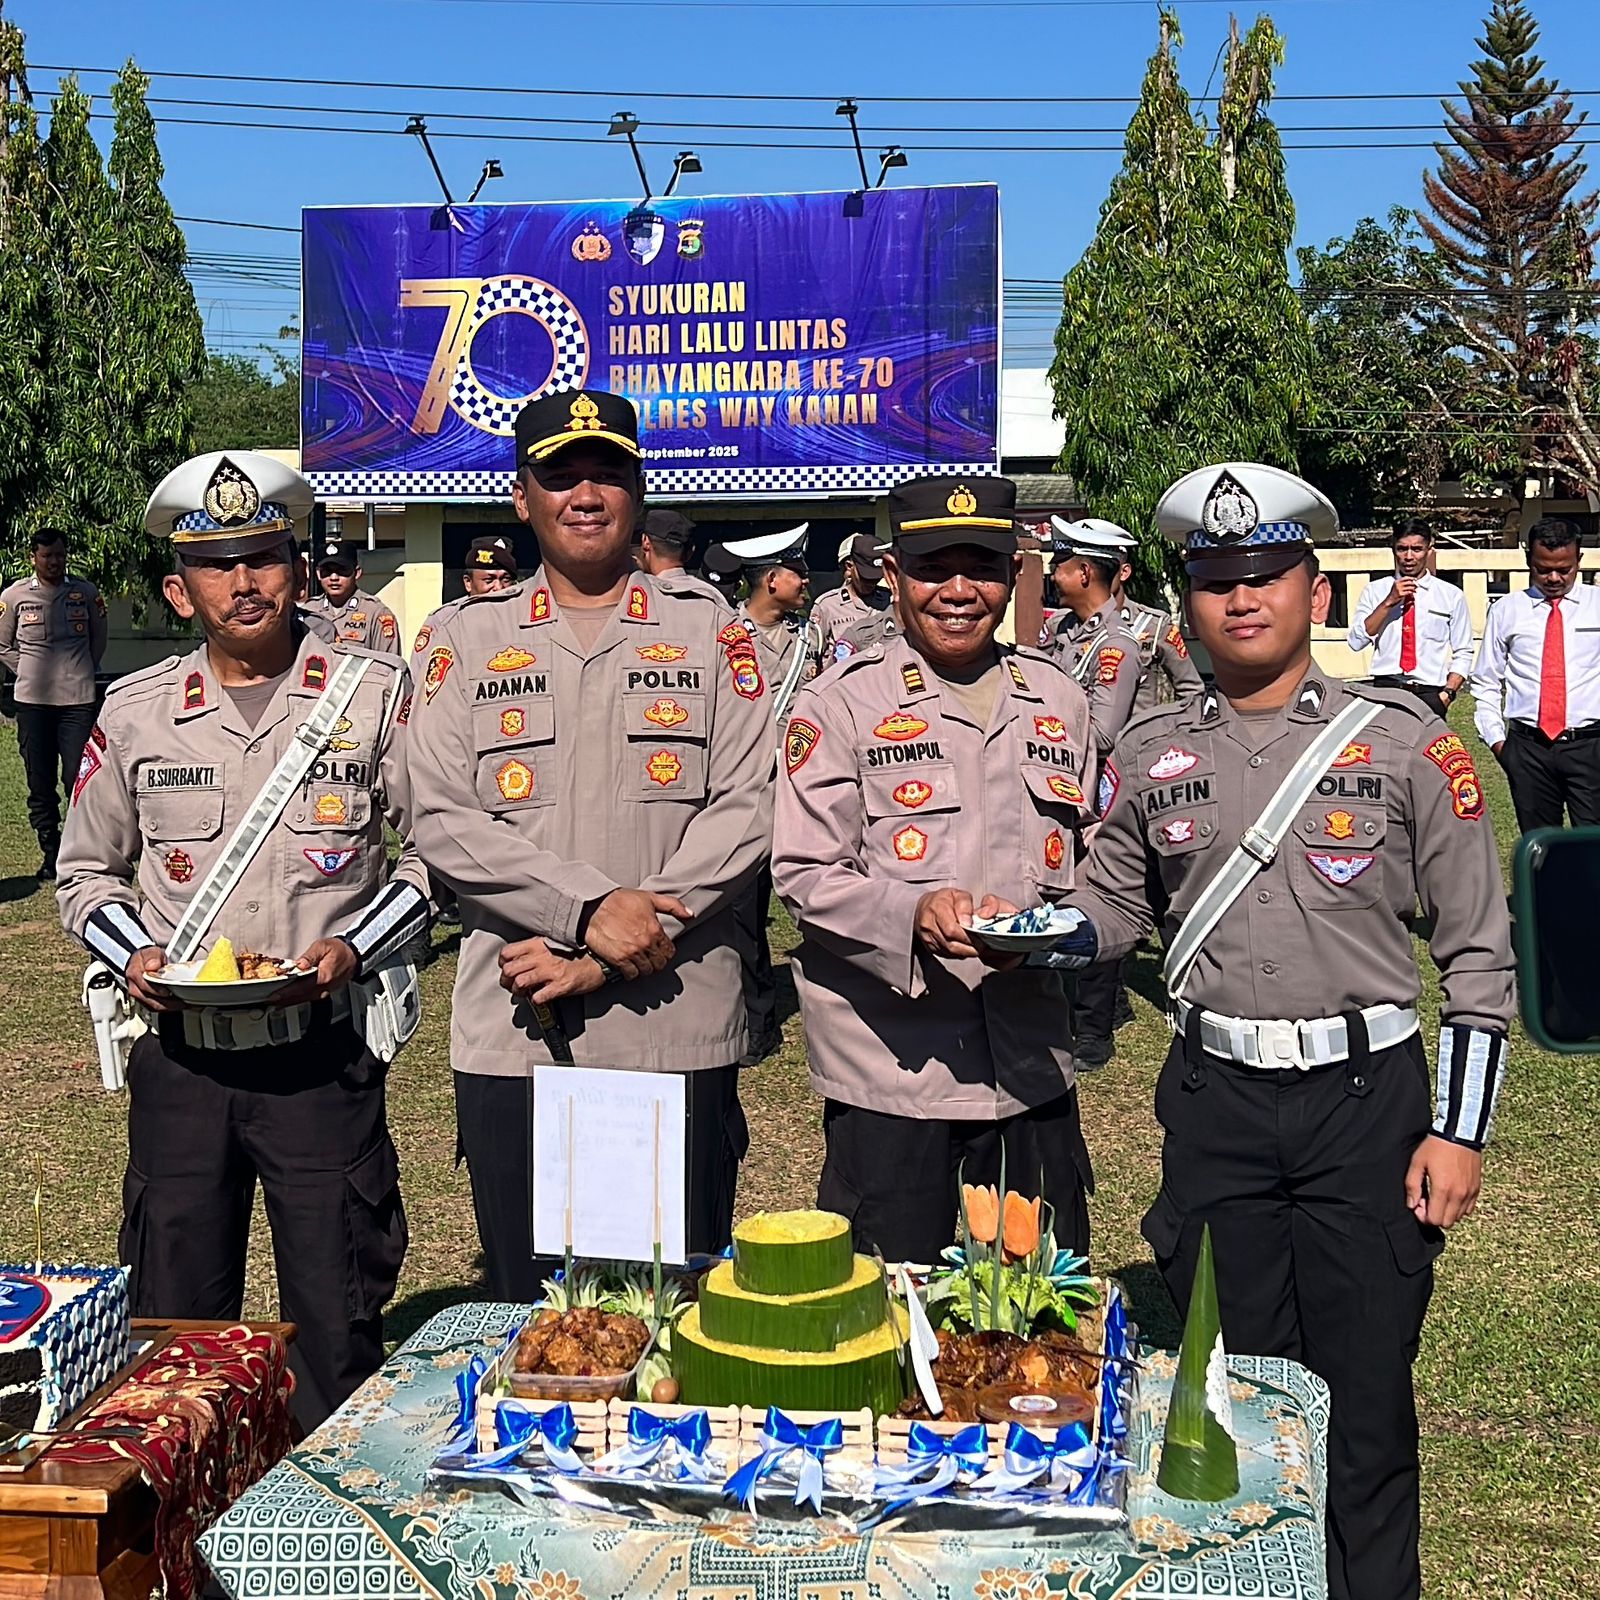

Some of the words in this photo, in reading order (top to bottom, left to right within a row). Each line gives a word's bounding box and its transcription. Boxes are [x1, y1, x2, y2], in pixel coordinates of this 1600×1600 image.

[608, 281, 746, 317] SYUKURAN
[609, 323, 671, 355] HARI
[680, 321, 745, 354] LALU
[755, 317, 847, 351] LINTAS
[609, 360, 801, 394] BHAYANGKARA
[812, 356, 894, 390] KE-70
[630, 398, 707, 430] LRES
[719, 396, 776, 428] WAY
[787, 393, 878, 425] KANAN
[639, 446, 705, 461] September
[708, 446, 739, 458] 2025
[475, 674, 547, 701] ADANAN
[628, 670, 700, 689] POLRI
[867, 741, 944, 767] SITOMPUL
[1026, 741, 1075, 770] POLRI
[147, 767, 214, 788] B.SURBAKTI
[312, 761, 367, 784] OLRI
[1147, 779, 1210, 813] ALFIN
[1316, 775, 1382, 800] OLRI
